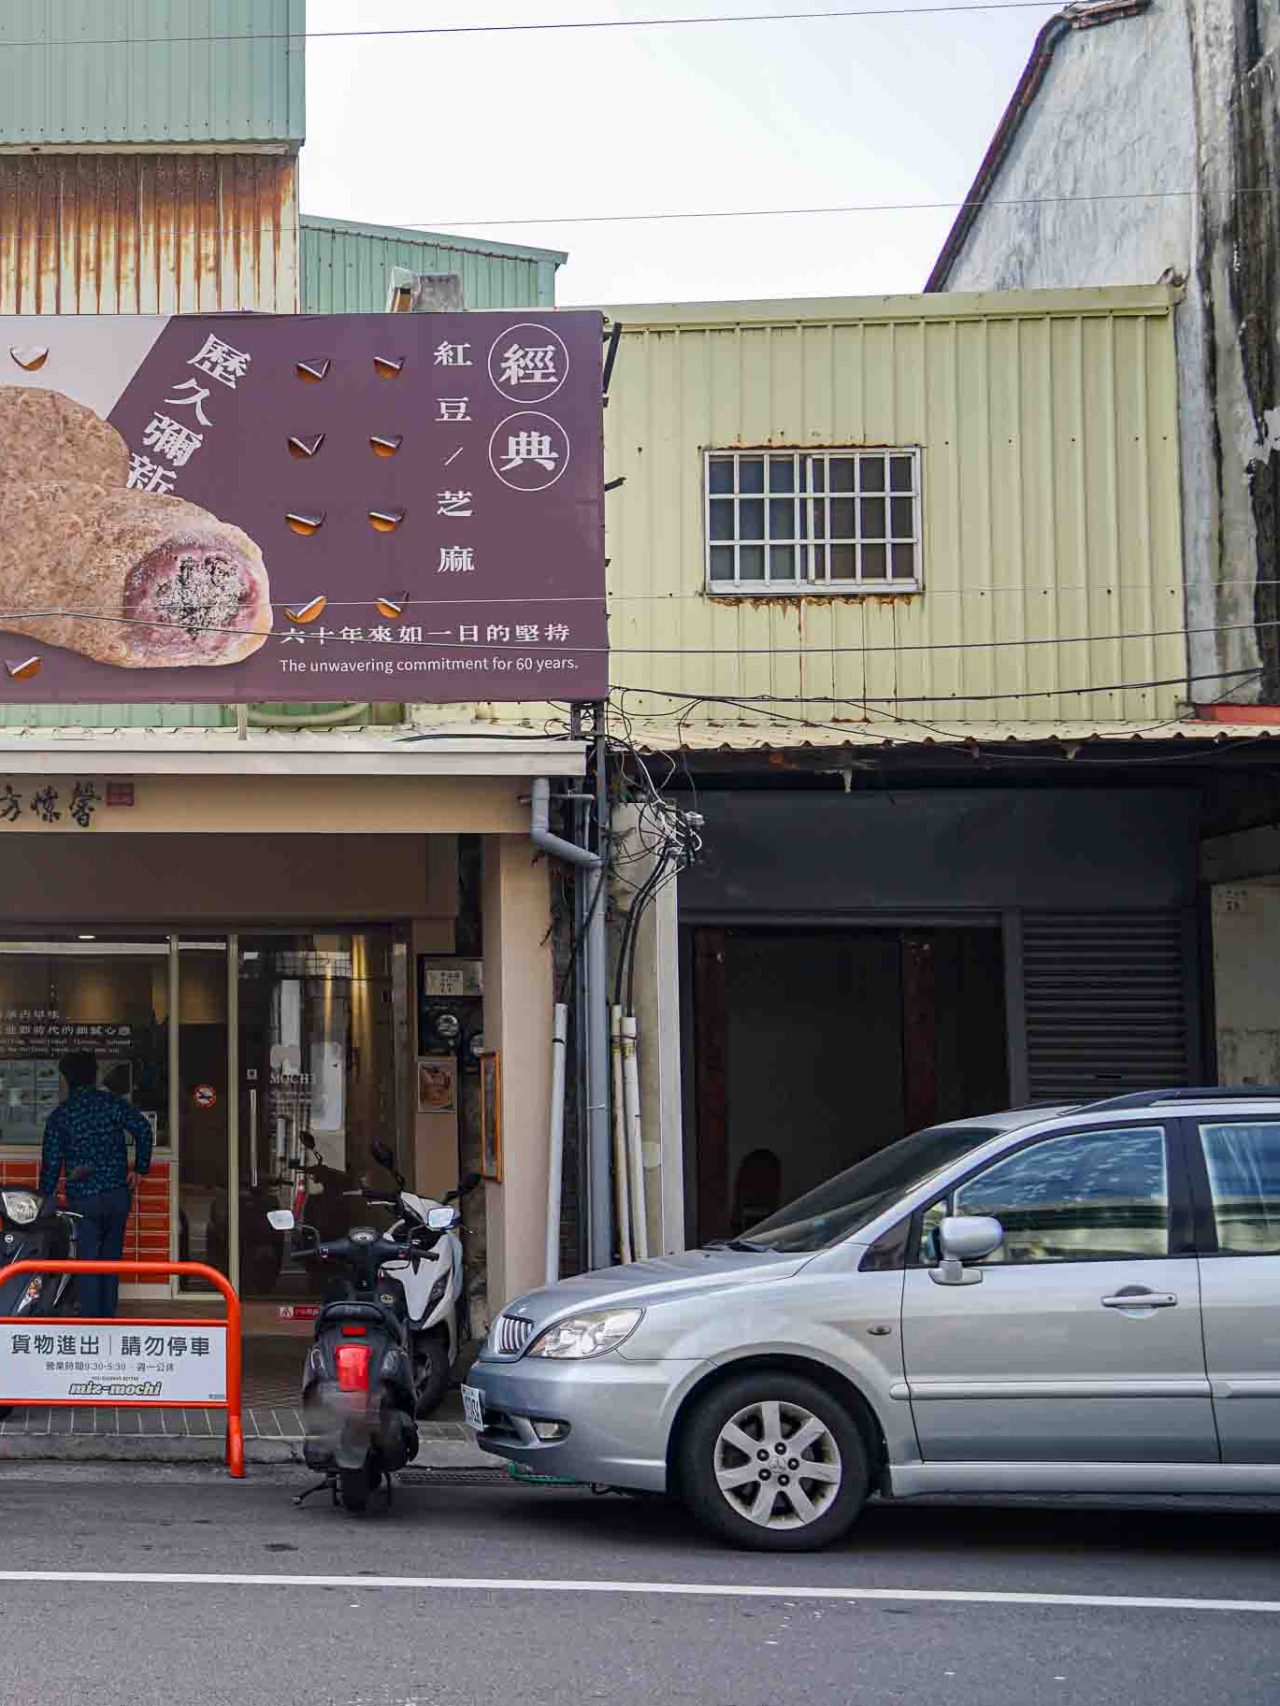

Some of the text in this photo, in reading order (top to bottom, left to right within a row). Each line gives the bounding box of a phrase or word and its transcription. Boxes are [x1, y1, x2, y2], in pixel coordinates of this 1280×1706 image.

[499, 344, 559, 471] 經典
[280, 624, 570, 645] 六十年來如一日的堅持
[280, 657, 578, 675] The unwavering commitment for 60 years.
[11, 1334, 210, 1357] 貨物進出 請勿停車
